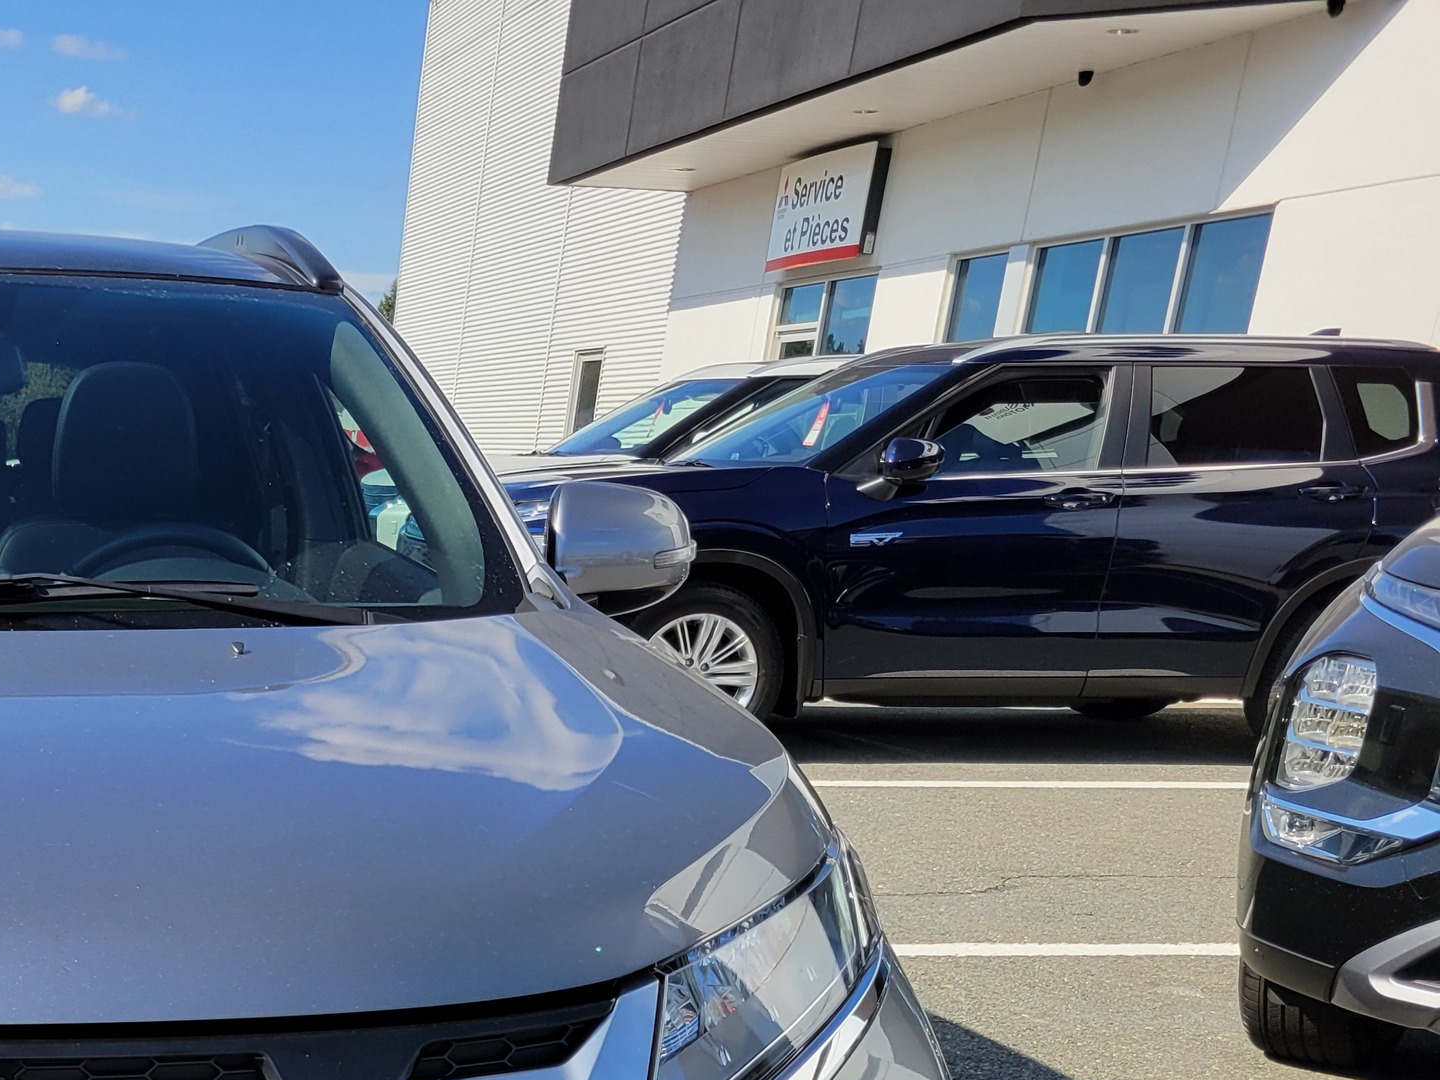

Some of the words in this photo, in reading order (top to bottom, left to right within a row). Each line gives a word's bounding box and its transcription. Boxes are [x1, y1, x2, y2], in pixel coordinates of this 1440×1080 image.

[791, 169, 844, 210] Service
[783, 221, 797, 252] et
[798, 213, 850, 249] Pièces
